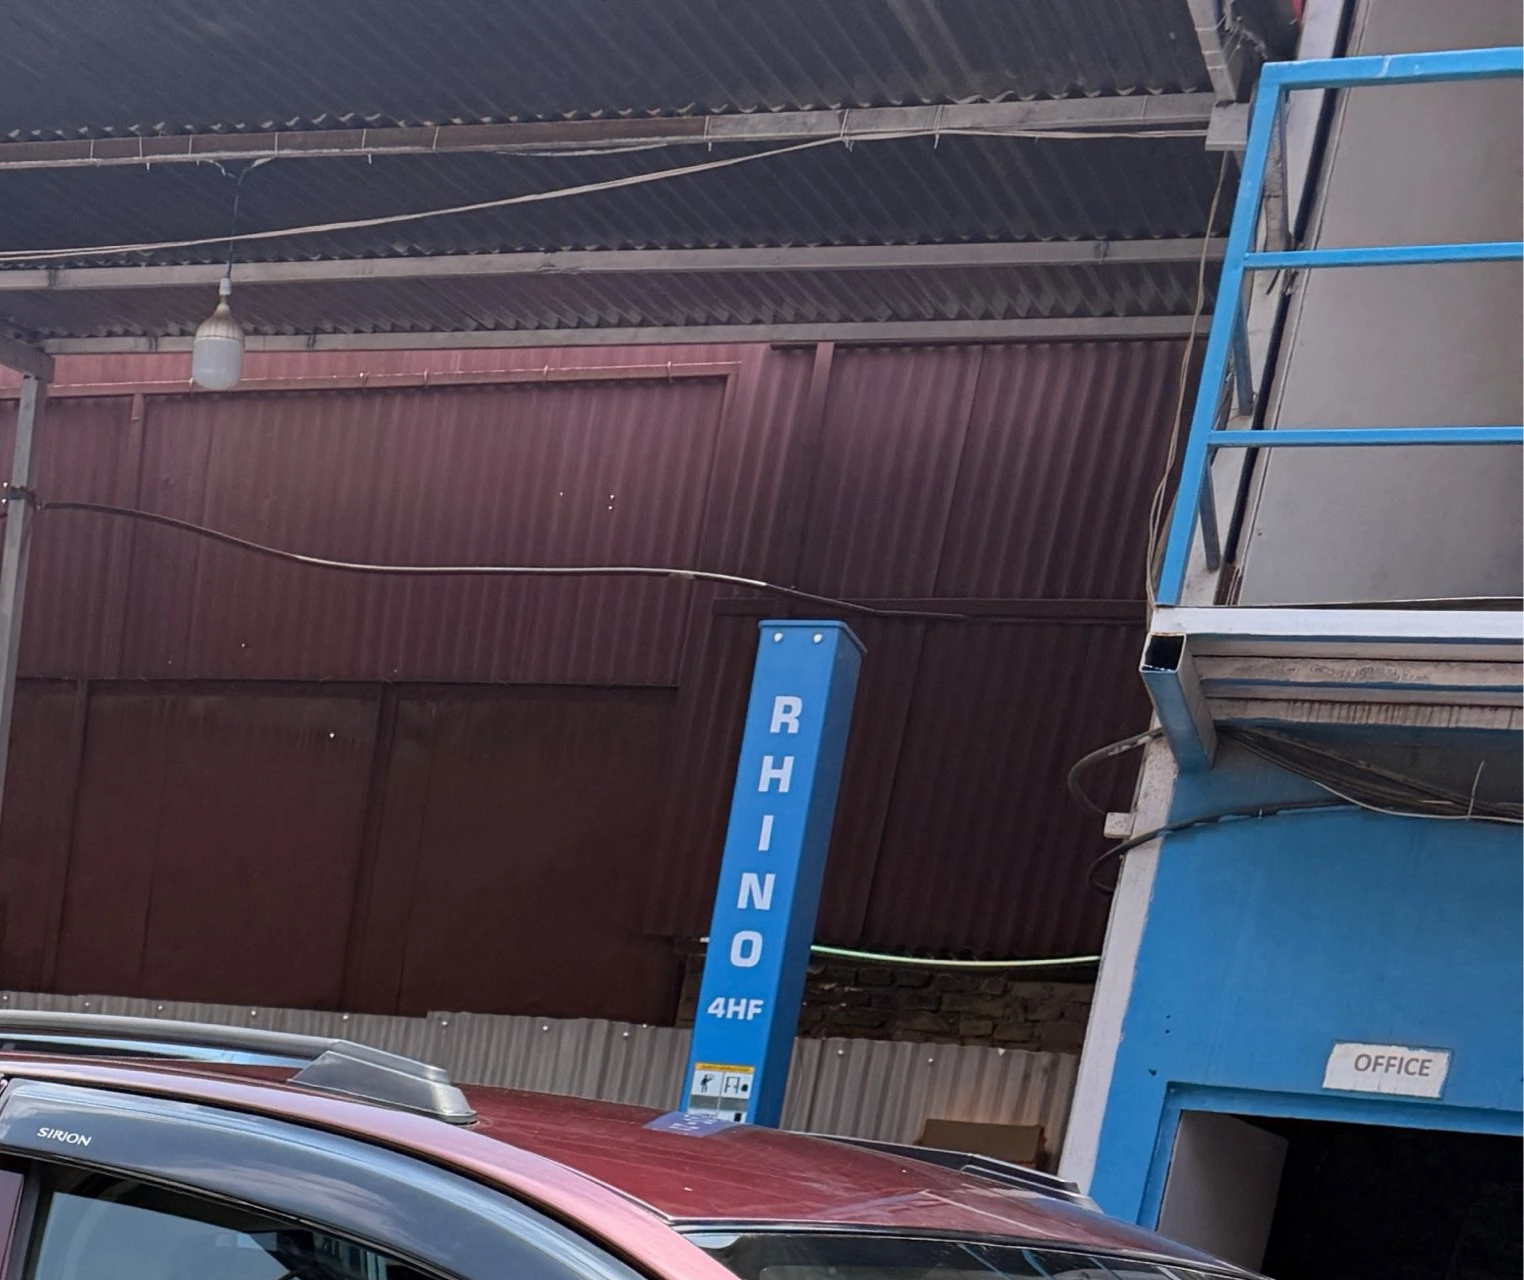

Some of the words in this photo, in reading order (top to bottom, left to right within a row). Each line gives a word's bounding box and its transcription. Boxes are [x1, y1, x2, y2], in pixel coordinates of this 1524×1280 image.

[729, 695, 804, 968] RHINO
[706, 997, 764, 1021] 4HF
[1353, 1053, 1433, 1077] OFFICE
[36, 1127, 93, 1147] SIRION
